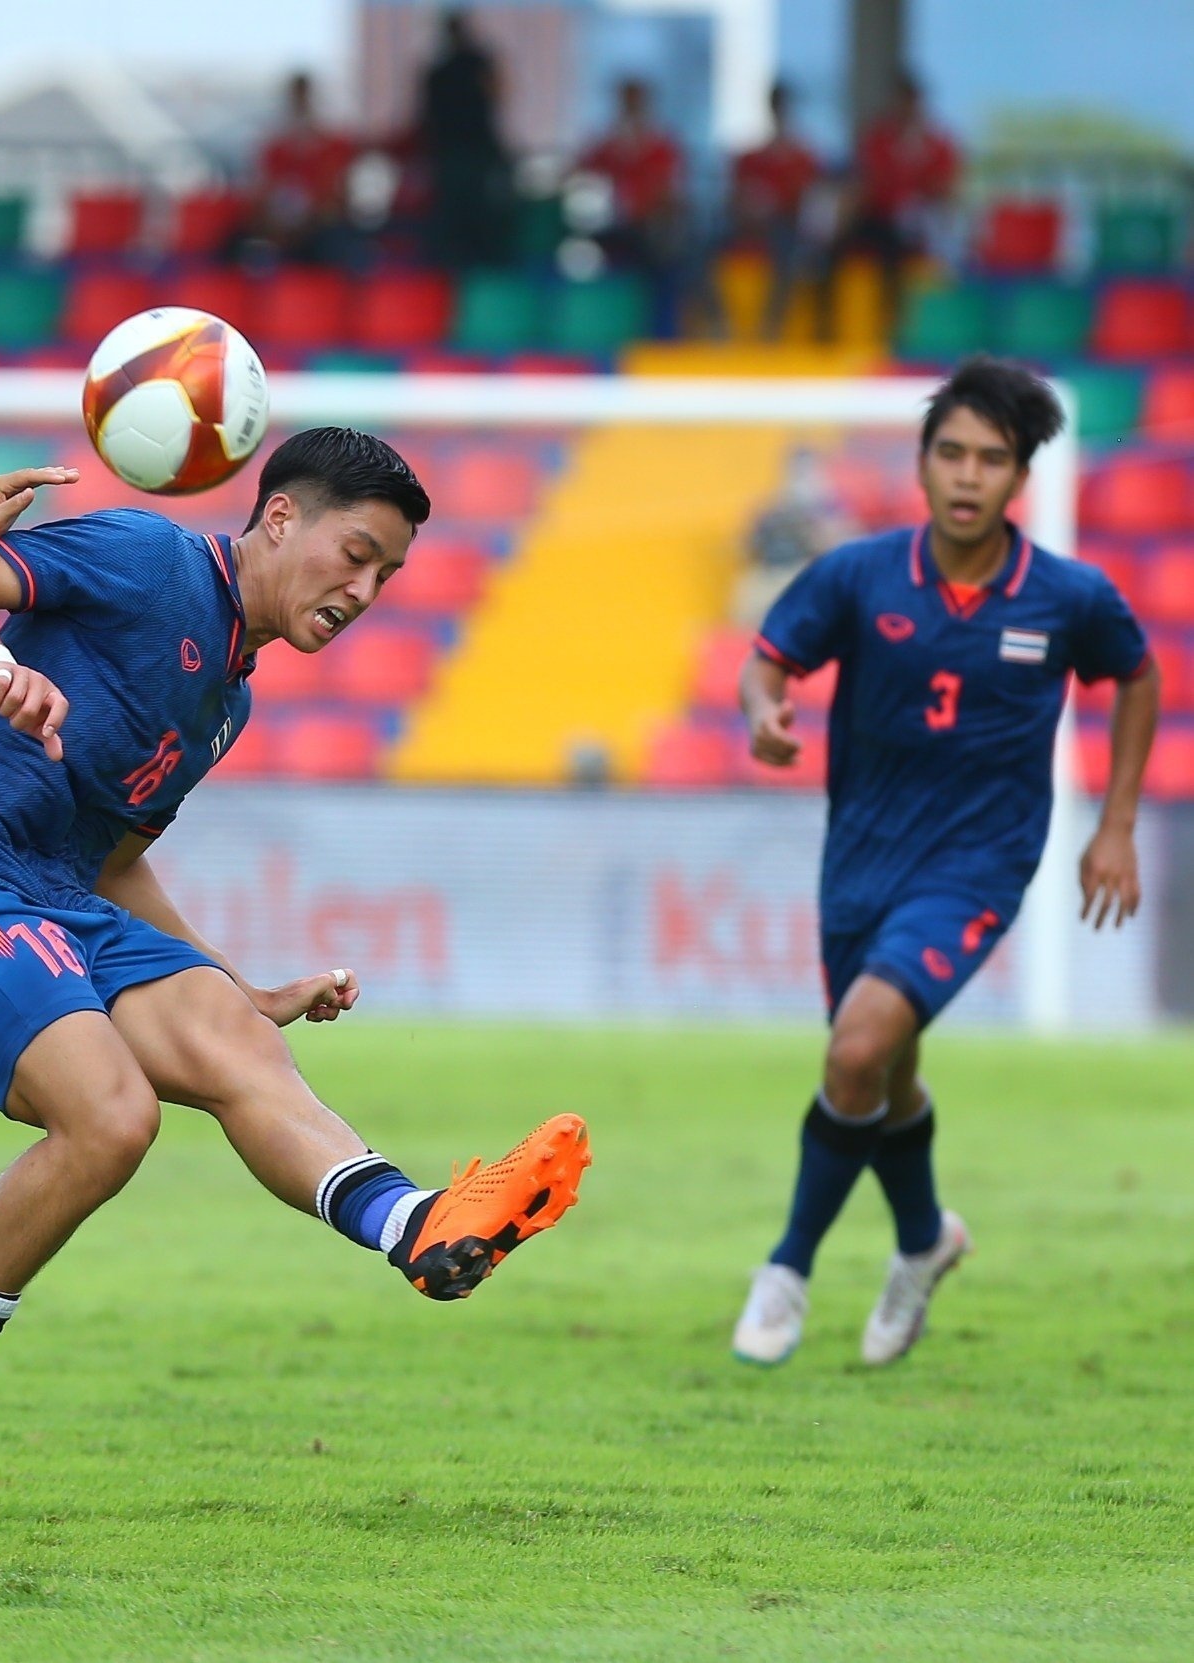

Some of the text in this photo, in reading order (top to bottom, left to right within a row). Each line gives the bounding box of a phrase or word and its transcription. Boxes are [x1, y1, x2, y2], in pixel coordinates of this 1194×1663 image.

[925, 671, 962, 730] 3
[121, 730, 183, 807] 16
[5, 920, 85, 978] 16
